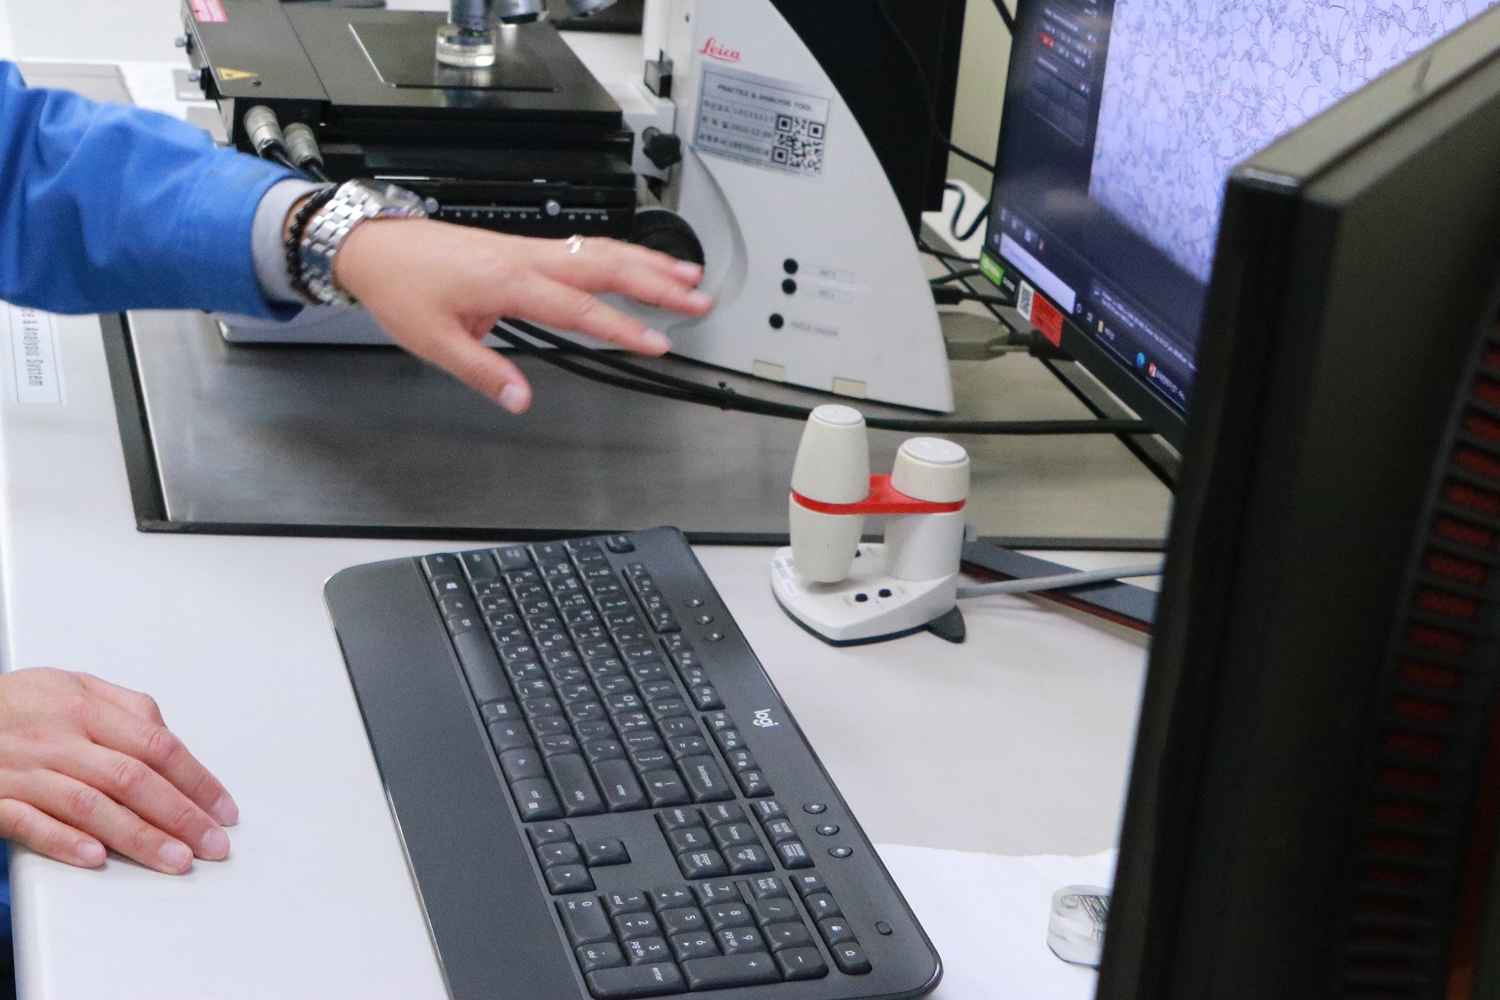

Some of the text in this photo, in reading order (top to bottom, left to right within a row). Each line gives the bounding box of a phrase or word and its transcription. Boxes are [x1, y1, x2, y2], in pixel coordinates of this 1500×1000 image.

[699, 37, 741, 62] Leica
[22, 327, 41, 356] Analysis
[25, 359, 44, 387] System
[753, 708, 779, 728] logi
[613, 895, 623, 904] end
[703, 883, 713, 897] home
[652, 967, 663, 981] enter
